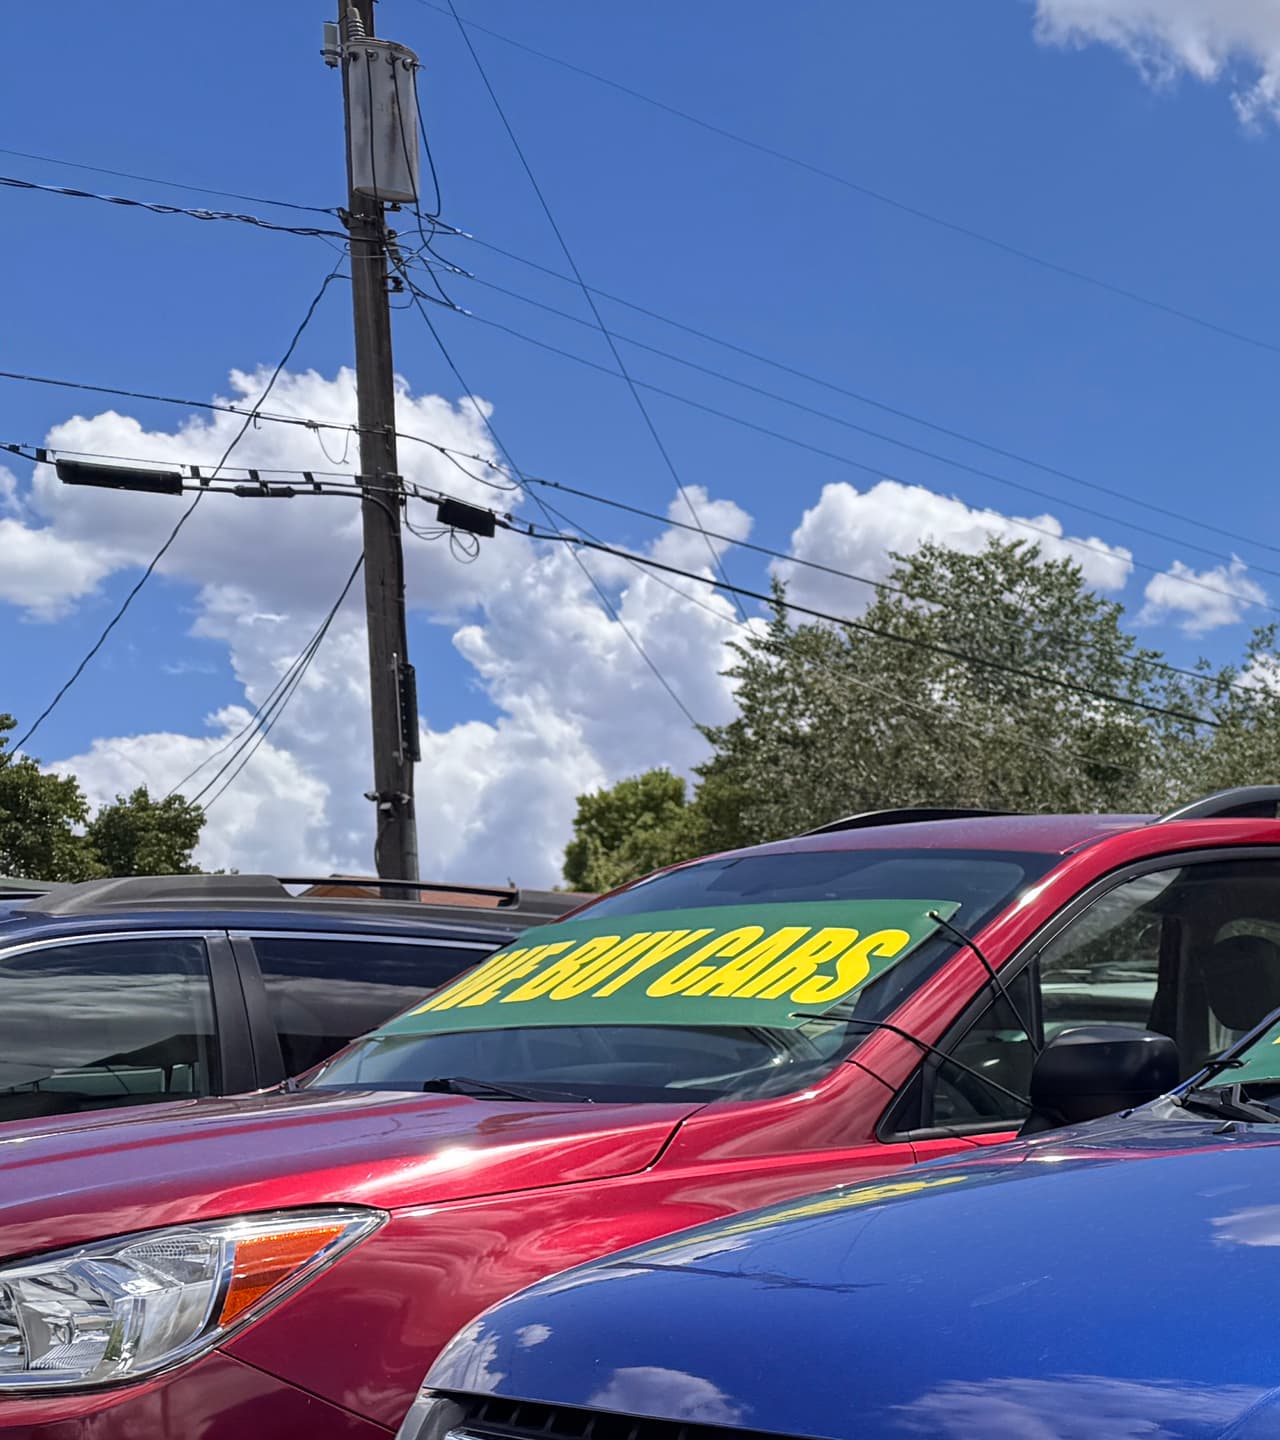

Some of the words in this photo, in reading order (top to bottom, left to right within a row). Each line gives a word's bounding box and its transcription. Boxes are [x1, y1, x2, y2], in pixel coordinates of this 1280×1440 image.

[407, 940, 577, 1016] WE
[499, 926, 712, 1003] BUY
[646, 926, 912, 1006] CARS
